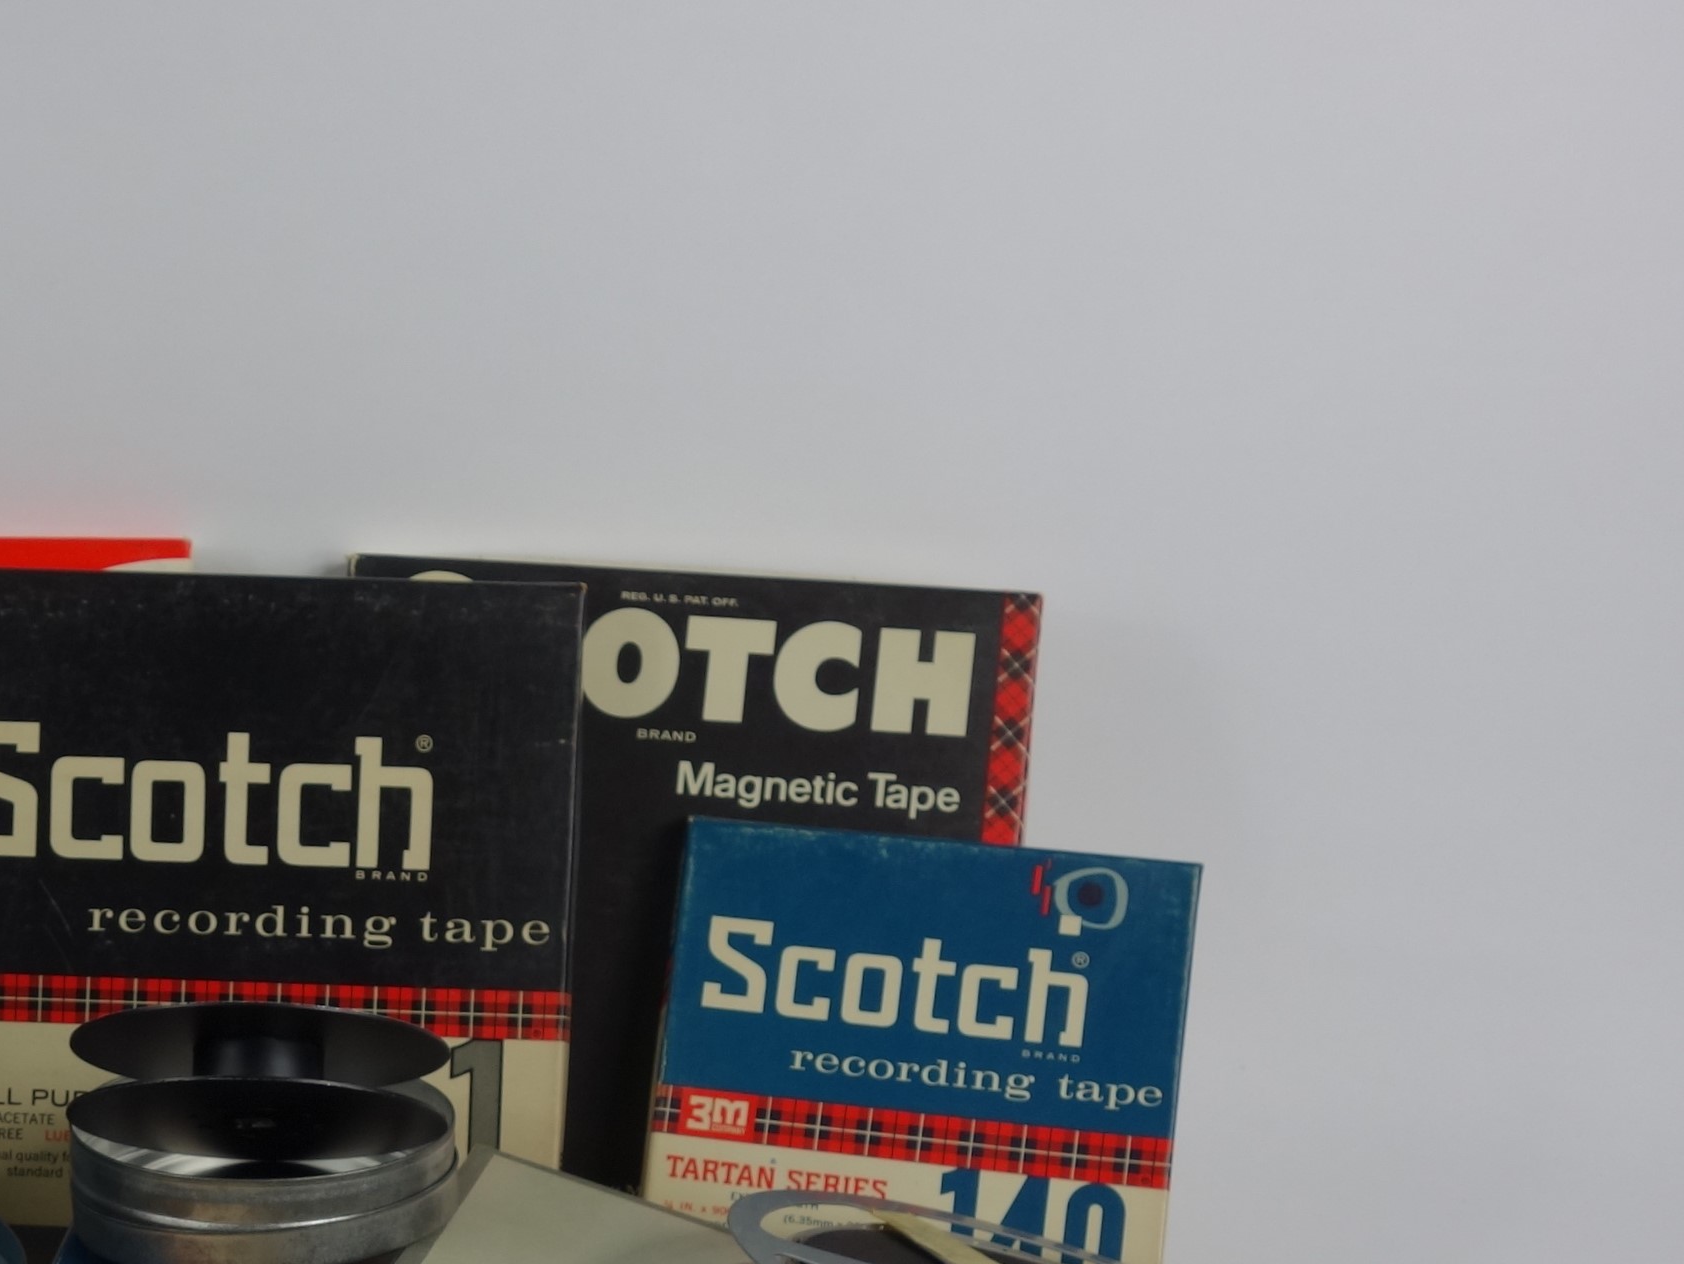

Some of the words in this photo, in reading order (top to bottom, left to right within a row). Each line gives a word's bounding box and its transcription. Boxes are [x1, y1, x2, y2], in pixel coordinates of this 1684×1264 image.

[583, 607, 977, 737] OTCH
[636, 729, 697, 743] BRAND
[676, 760, 860, 809] Magnetic
[867, 773, 961, 819] Tape
[355, 870, 429, 883] BRAND
[88, 907, 397, 949] recording
[421, 913, 551, 952] tape
[700, 914, 1090, 1048] Scotch
[789, 1047, 1035, 1101] recording
[1057, 1074, 1163, 1110] tape
[1021, 1048, 1081, 1064] BRAND
[686, 1095, 750, 1131] 3M
[667, 1154, 776, 1189] TARTAN
[787, 1169, 888, 1200] SERIES
